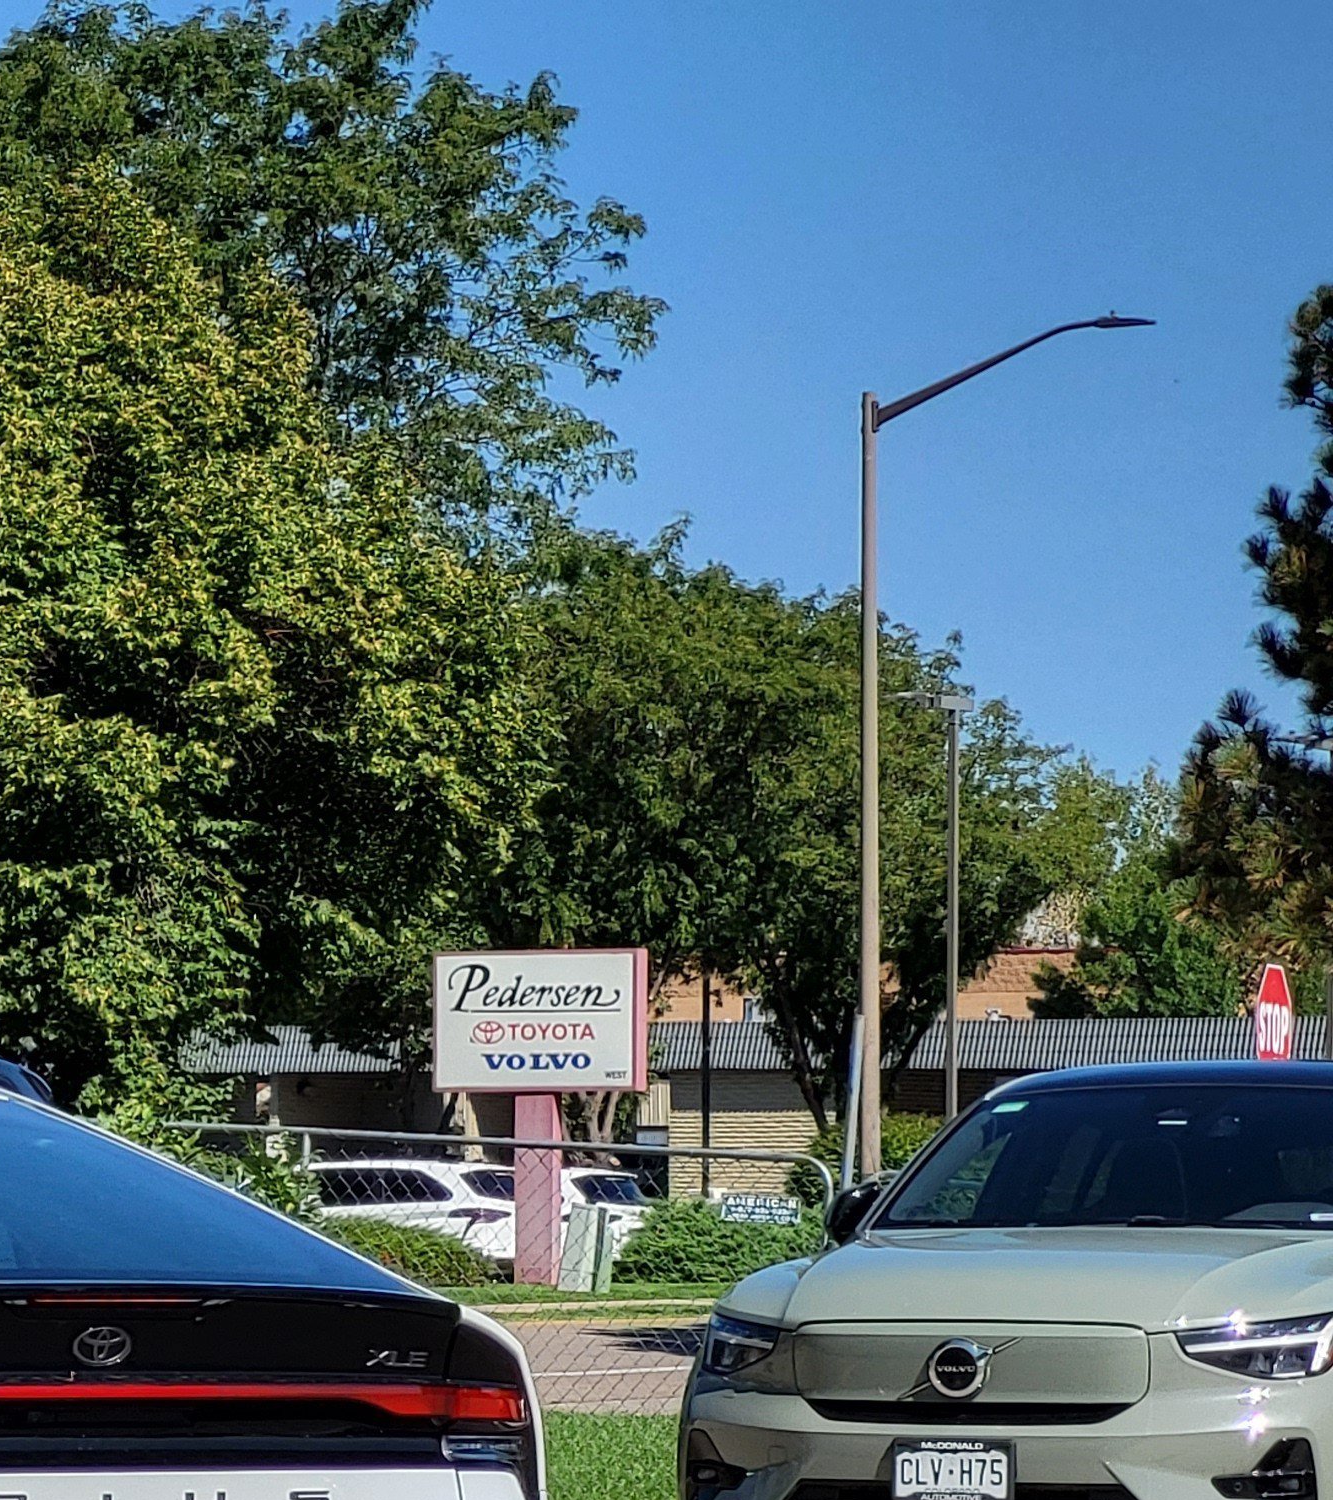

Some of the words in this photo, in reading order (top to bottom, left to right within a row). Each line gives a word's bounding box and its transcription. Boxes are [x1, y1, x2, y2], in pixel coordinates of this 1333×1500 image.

[447, 963, 621, 1013] Pedersen
[507, 1023, 595, 1041] TOYOTA
[1259, 1001, 1290, 1055] STOP
[481, 1053, 592, 1071] VOLVO
[604, 1070, 628, 1080] WEST
[365, 1349, 430, 1368] XLE
[936, 1365, 976, 1373] VOLVO
[920, 1441, 984, 1450] McDONALD
